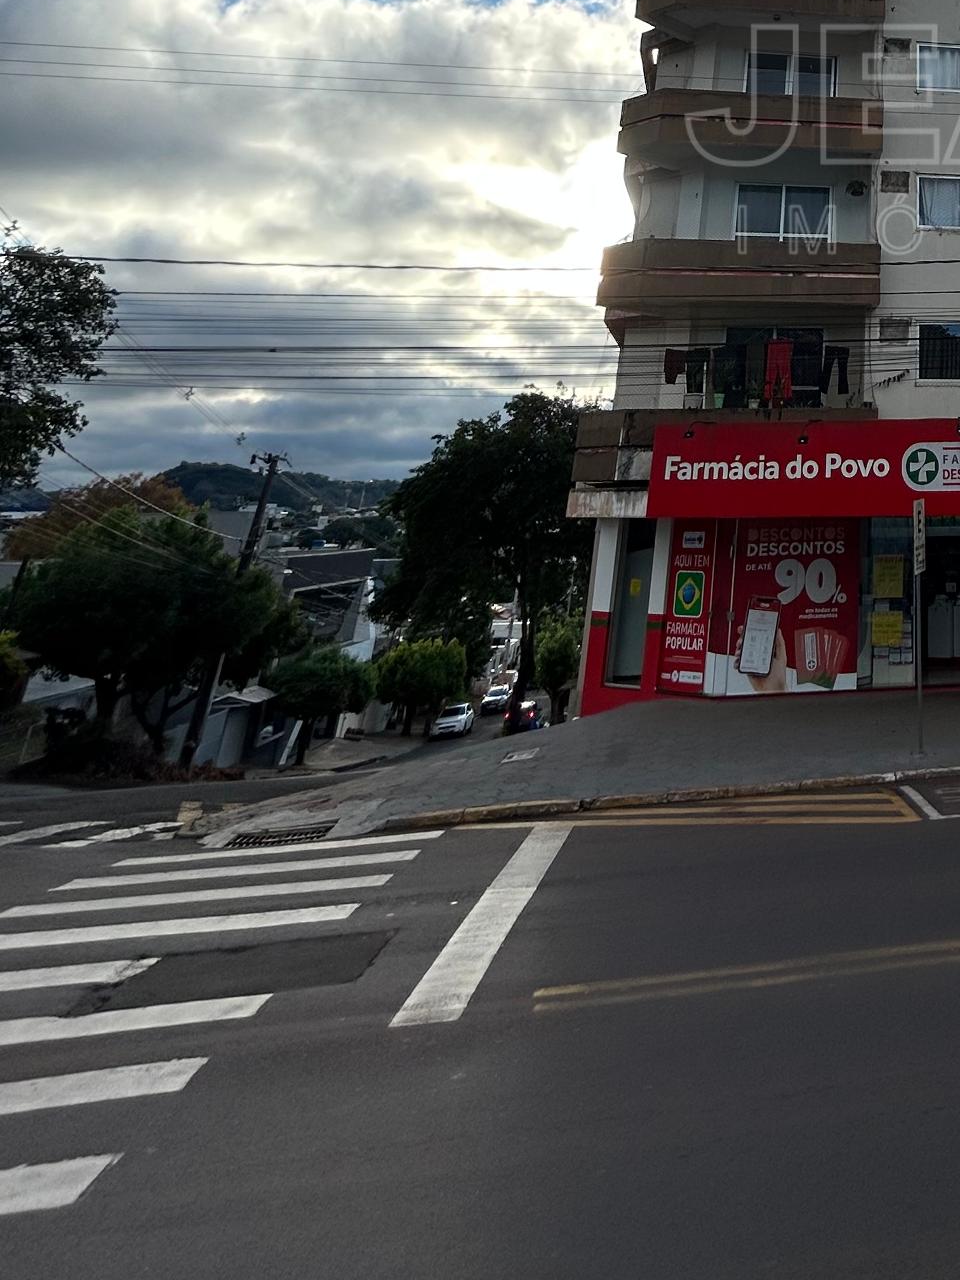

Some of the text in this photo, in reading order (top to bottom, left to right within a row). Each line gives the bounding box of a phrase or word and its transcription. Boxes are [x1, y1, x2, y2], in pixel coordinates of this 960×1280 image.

[664, 453, 890, 480] Farmácia do Povo
[748, 527, 845, 541] DESCONTOS
[746, 541, 846, 557] DESCONTOS
[674, 554, 710, 568] AQUI TEM
[757, 562, 771, 571] ATÉ
[774, 558, 847, 605] 90%
[666, 619, 705, 636] FARMÁCIA
[665, 636, 704, 651] POPULAR
